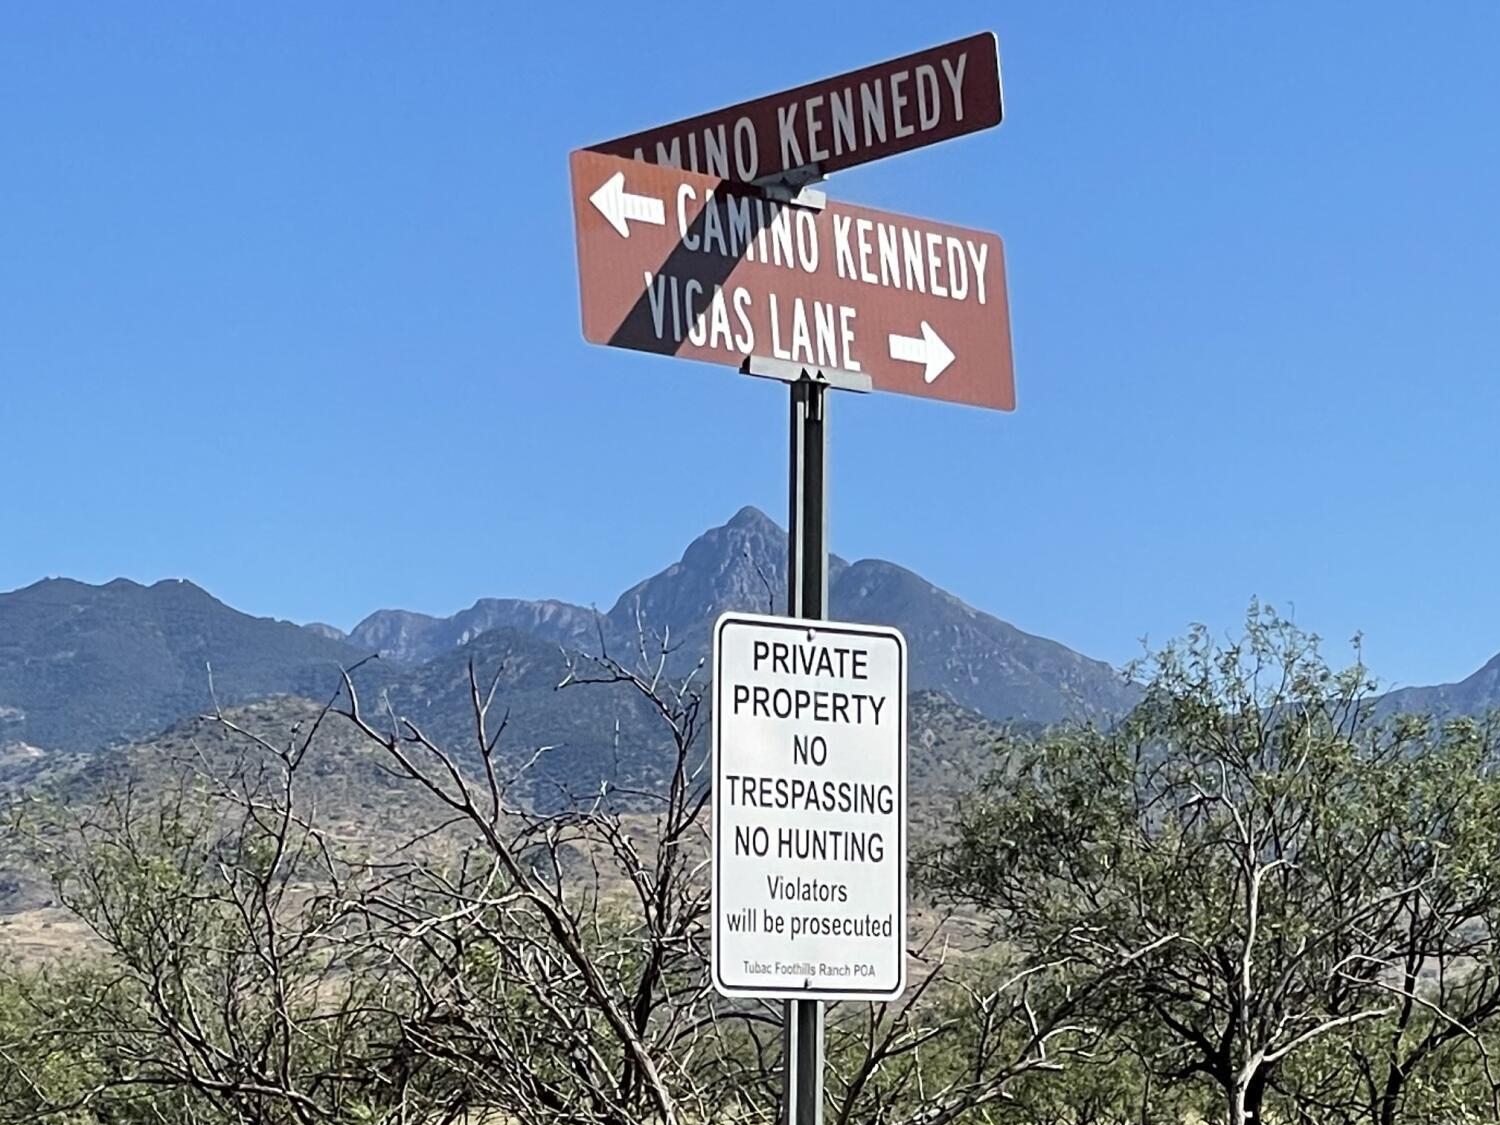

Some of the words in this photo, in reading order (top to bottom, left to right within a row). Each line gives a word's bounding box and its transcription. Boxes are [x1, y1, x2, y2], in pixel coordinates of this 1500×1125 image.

[778, 52, 968, 170] KENNEDY
[677, 183, 819, 273] CAMINO
[833, 213, 988, 305] KENNEDY
[644, 271, 753, 355] VIGAS
[769, 293, 861, 372] LANE
[753, 640, 868, 680] PRIVATE
[734, 684, 886, 725] PROPERTY
[793, 734, 828, 766] NO
[726, 775, 894, 815] TRESPASSING
[735, 825, 769, 857] NO
[778, 828, 884, 863] HUNTING
[767, 875, 848, 903] Violators
[727, 909, 757, 933] will
[764, 910, 785, 934] be
[791, 914, 893, 940] prosecuted
[744, 961, 772, 974] Tubac
[775, 962, 816, 976] Foothills
[819, 963, 850, 976] Ranch
[854, 964, 876, 977] POA
